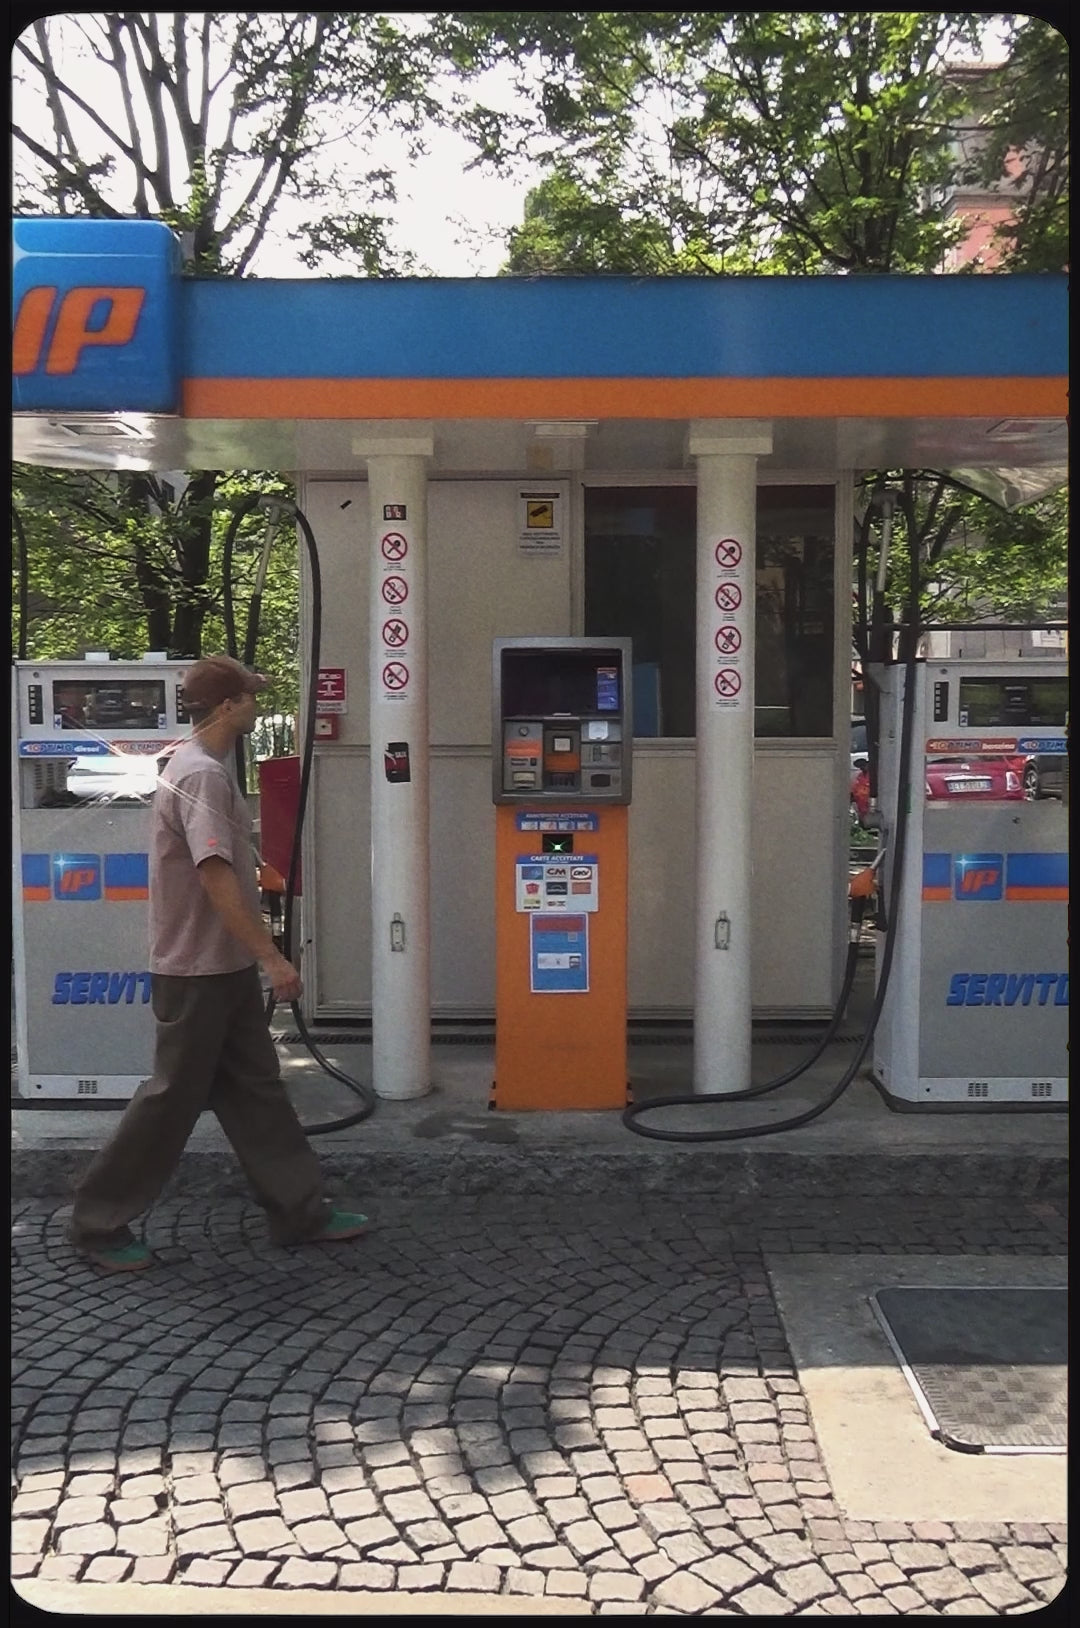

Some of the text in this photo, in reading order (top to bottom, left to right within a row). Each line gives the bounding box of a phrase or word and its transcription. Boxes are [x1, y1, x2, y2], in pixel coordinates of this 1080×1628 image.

[12, 285, 146, 375] IP
[60, 869, 95, 892] IP
[961, 869, 998, 892] IP
